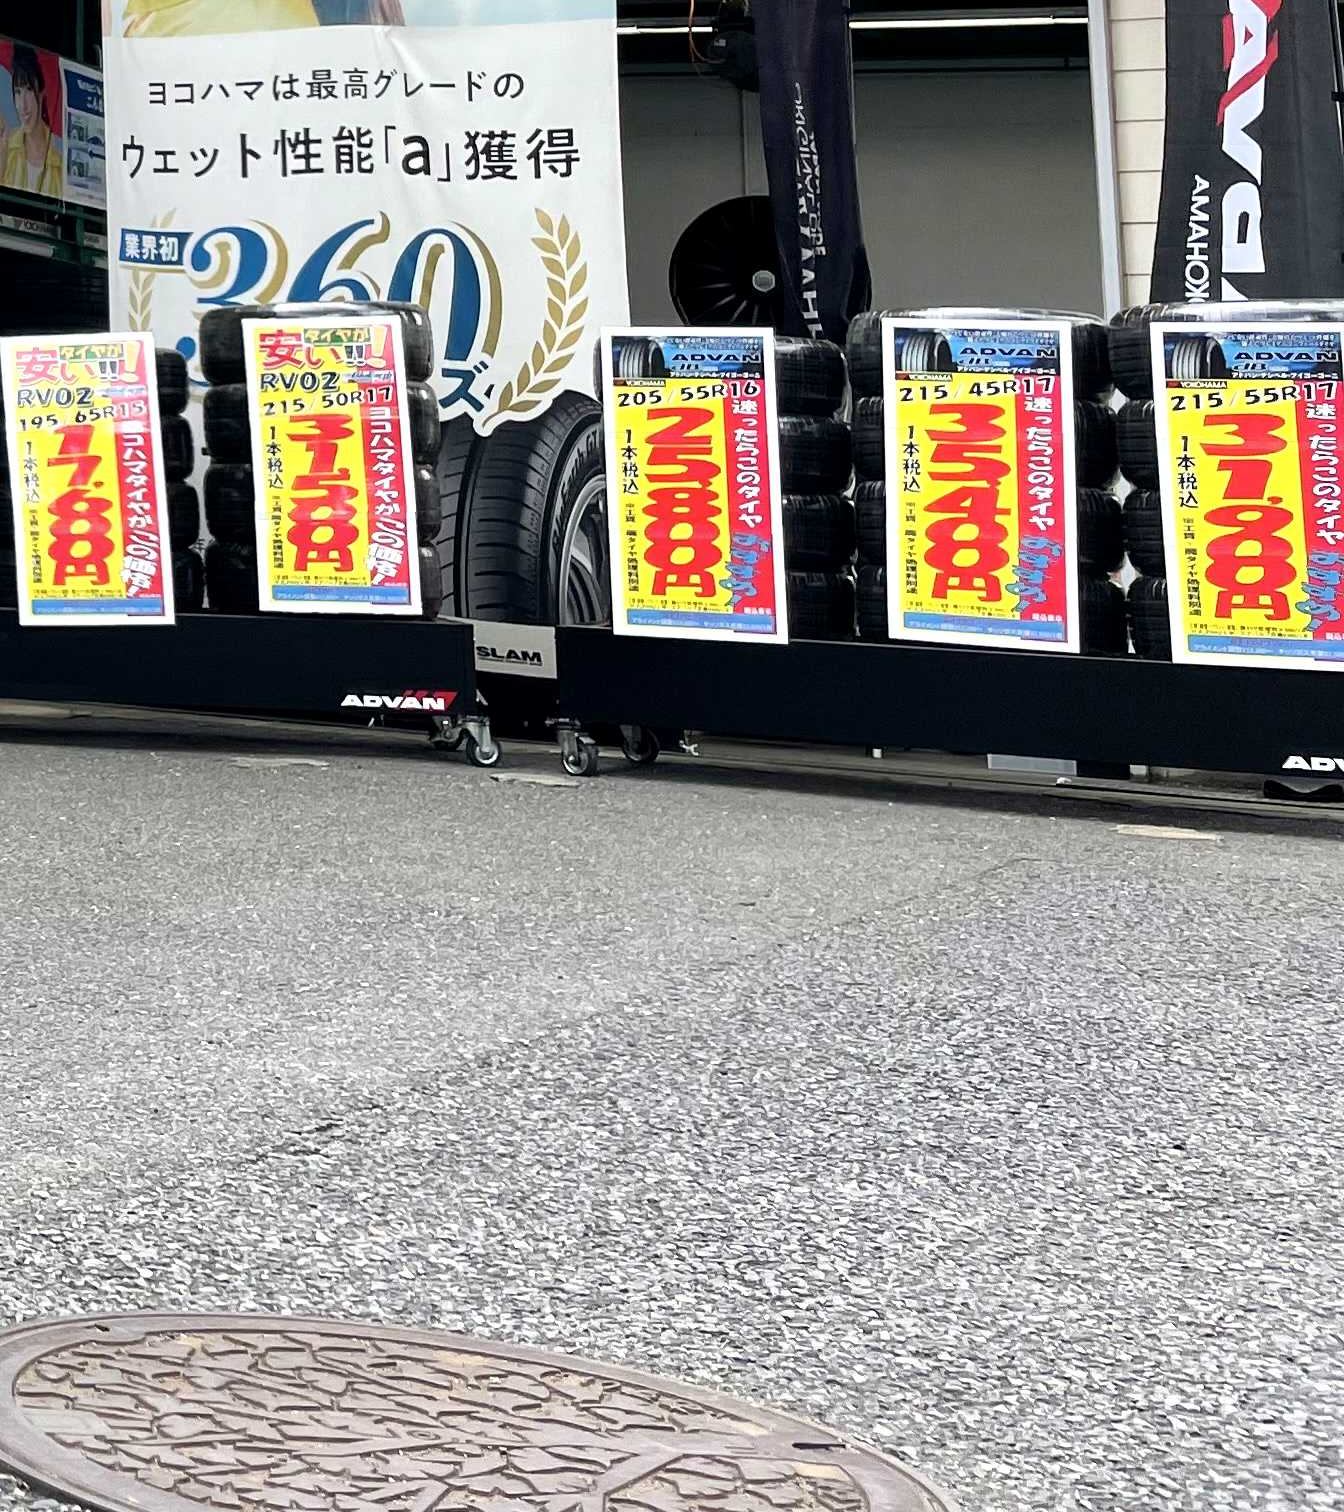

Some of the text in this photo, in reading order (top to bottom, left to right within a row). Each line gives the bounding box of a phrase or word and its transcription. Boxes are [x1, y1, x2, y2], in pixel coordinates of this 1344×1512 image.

[148, 67, 525, 105] ヨコハマは最高グレードの
[121, 125, 581, 182] ウェット性能「a」獲得
[124, 232, 179, 262] 業界初
[672, 353, 760, 363] ADVAN
[959, 348, 1056, 358] ADVAN
[1233, 351, 1338, 361] ADVAN
[340, 694, 445, 710] ADVAN
